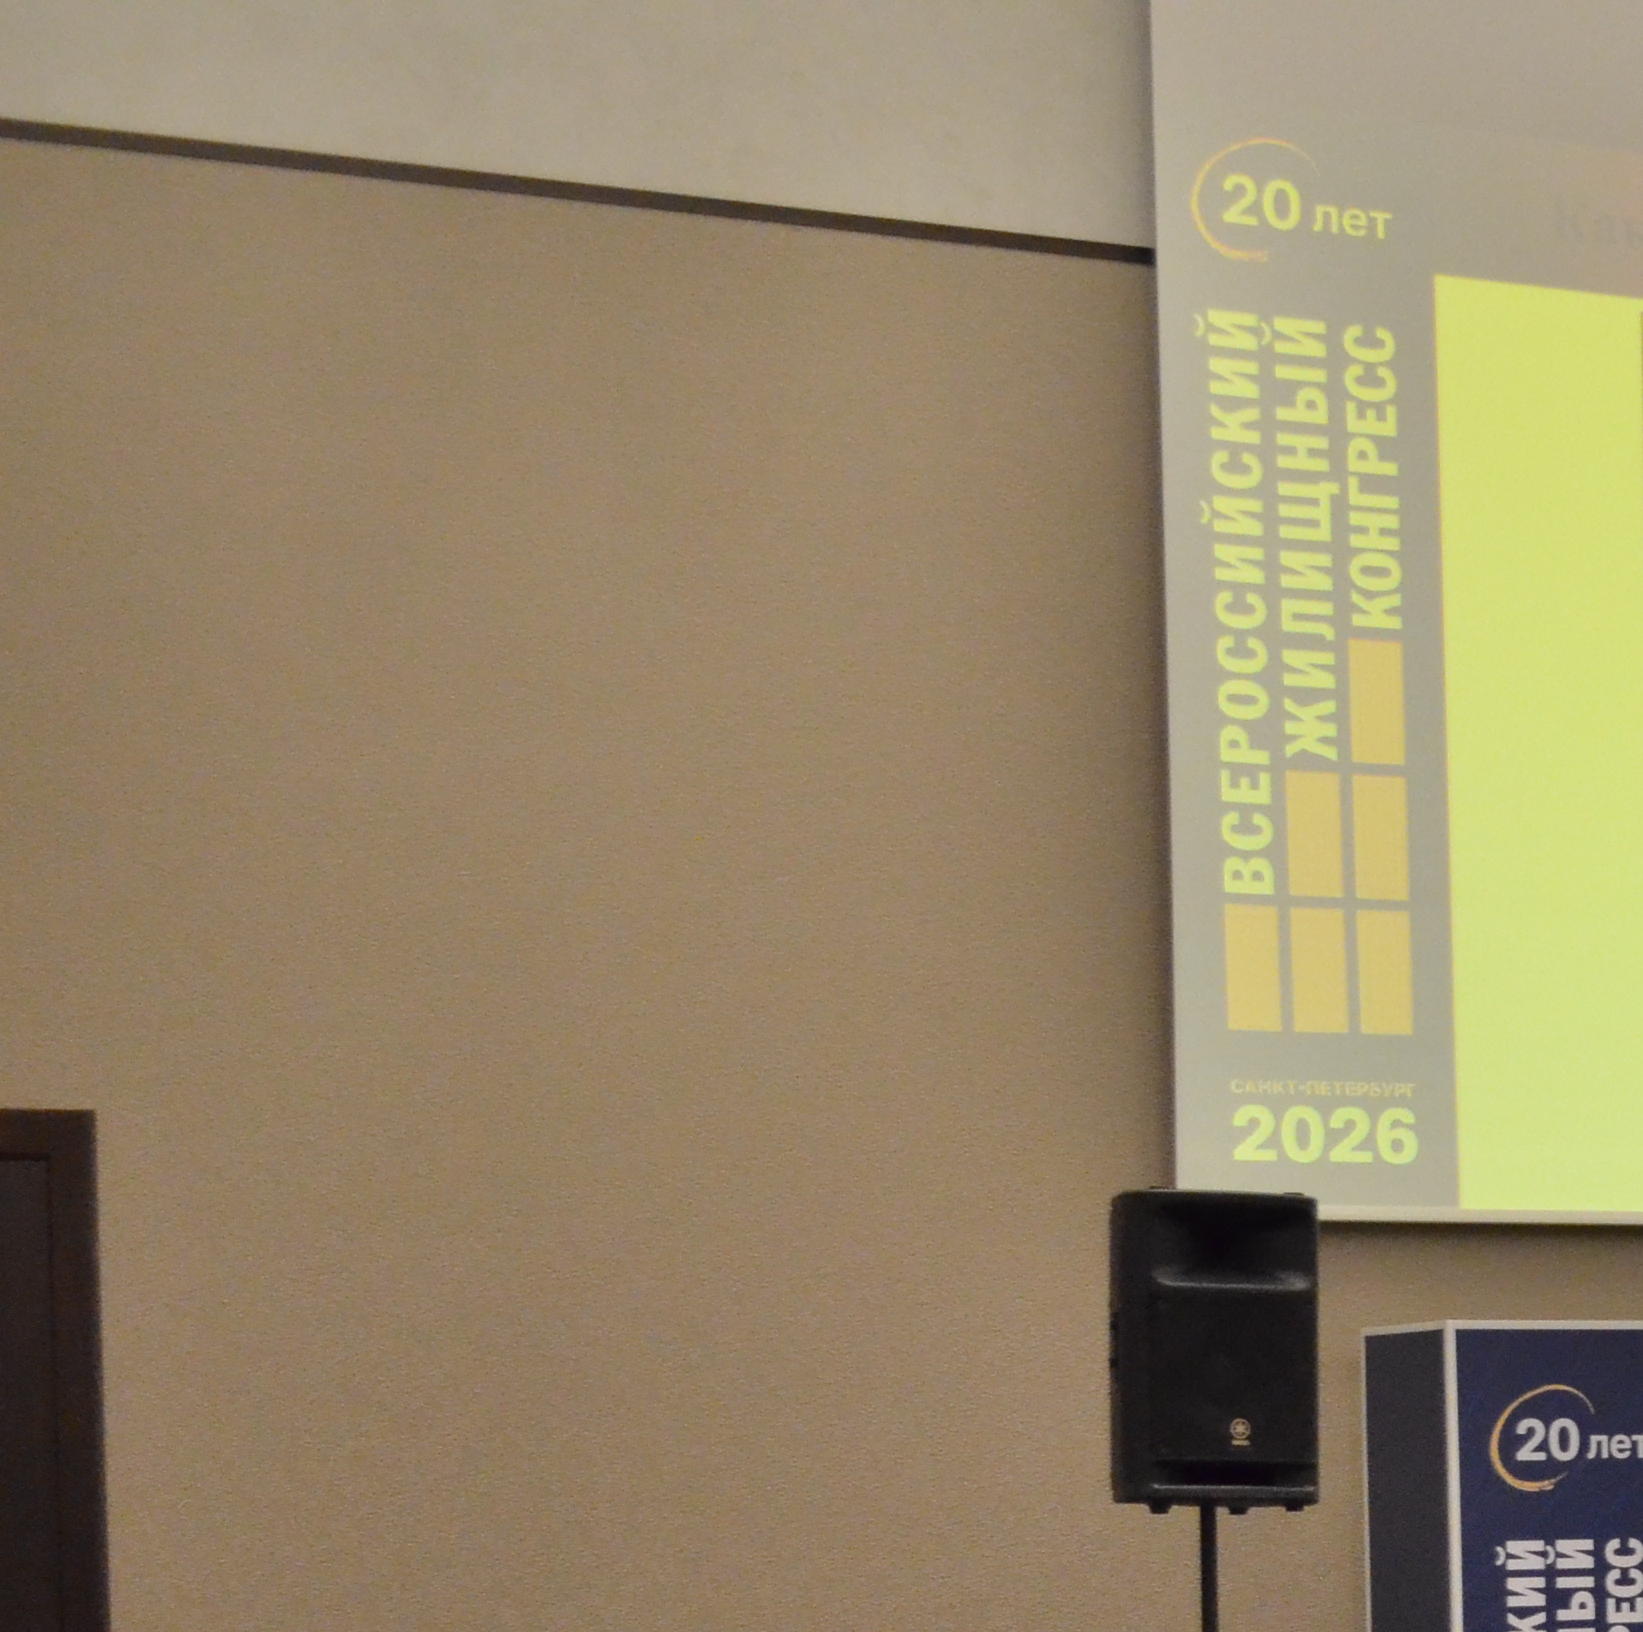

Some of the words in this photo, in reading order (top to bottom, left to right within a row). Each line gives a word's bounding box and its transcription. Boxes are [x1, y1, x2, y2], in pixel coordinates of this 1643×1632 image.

[1221, 173, 1302, 231] 20
[1312, 203, 1394, 240] лет
[1343, 323, 1403, 632] КОНГРЕСС
[1259, 315, 1341, 762] ЖИЛИЩНЫЙ
[1194, 308, 1276, 897] ВСЕРОССИЙСКИЙ
[1230, 1078, 1416, 1098] САНКТ-ПЕТЕРБУРГ
[1232, 1103, 1419, 1165] 2026
[1514, 1417, 1581, 1462] 20
